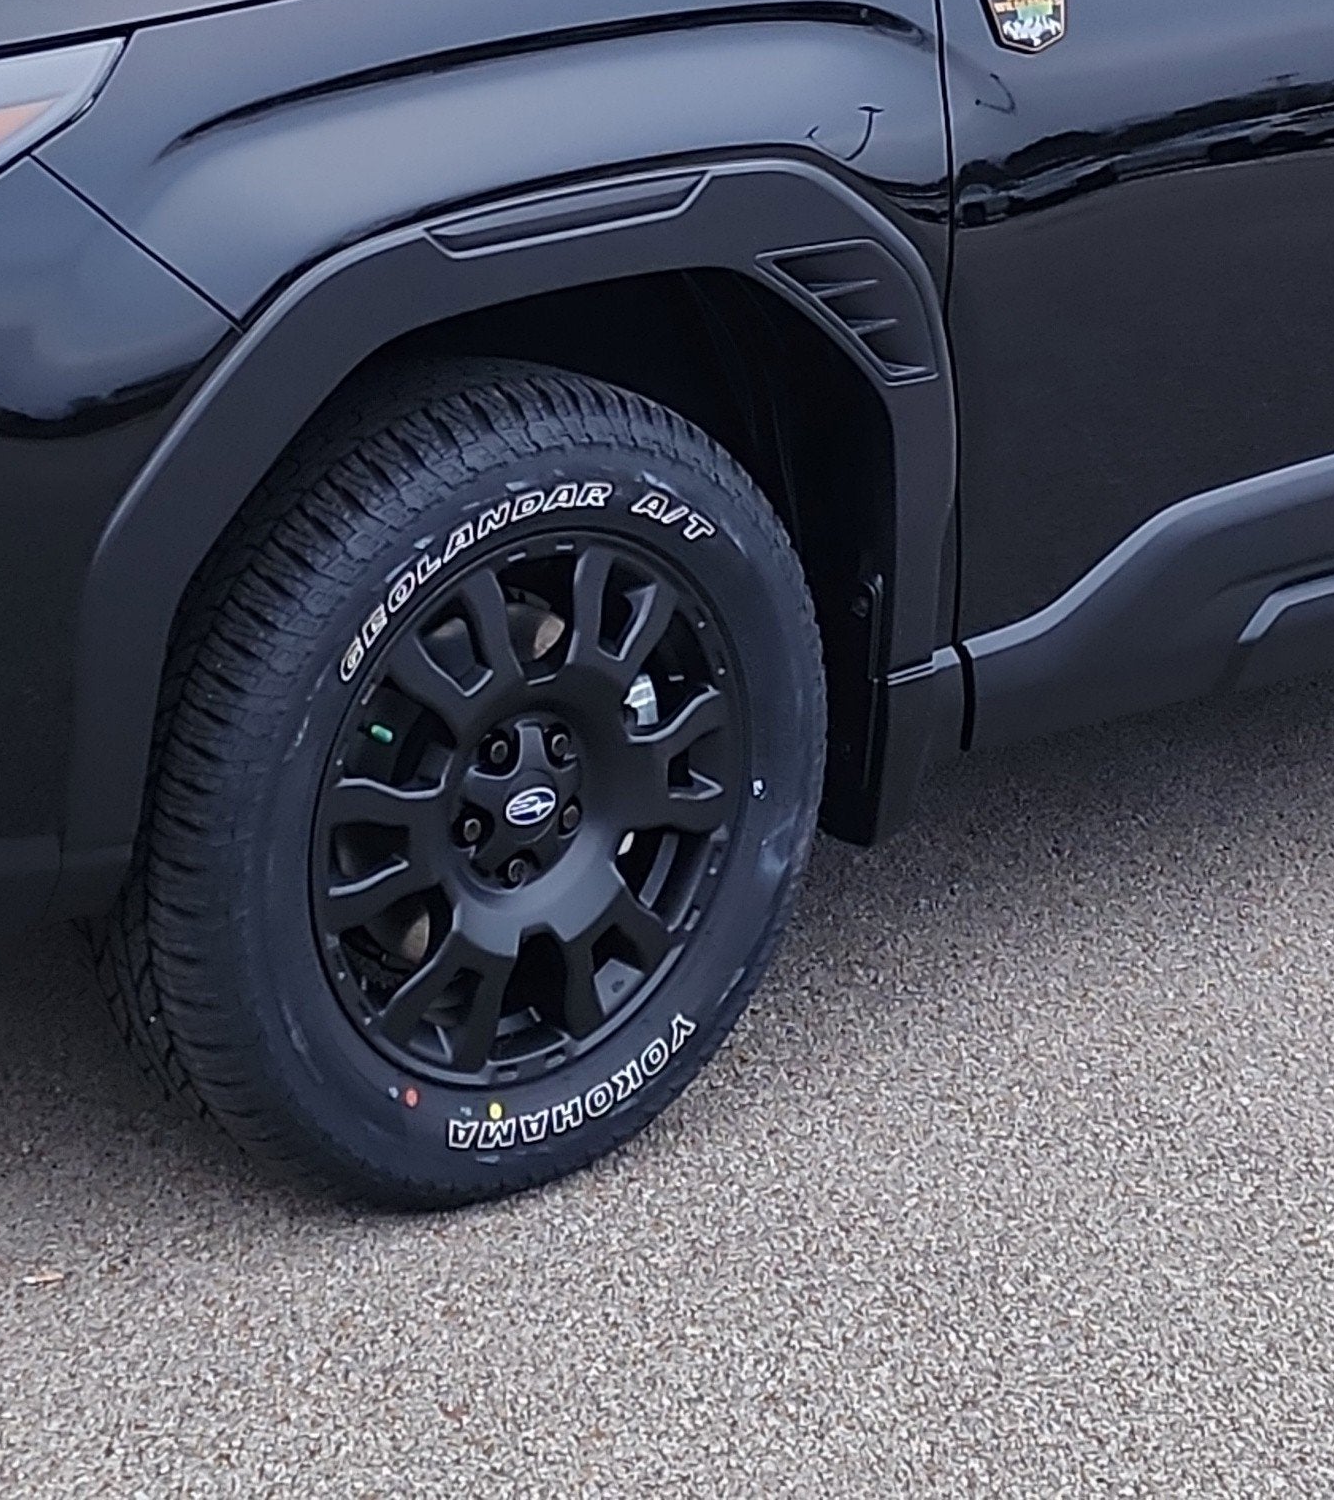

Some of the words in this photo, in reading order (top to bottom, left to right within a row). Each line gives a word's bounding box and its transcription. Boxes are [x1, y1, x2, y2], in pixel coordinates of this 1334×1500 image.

[339, 481, 614, 682] GEOLANDAR
[630, 491, 717, 541] A/T
[447, 1012, 698, 1149] YOKOHAMA
